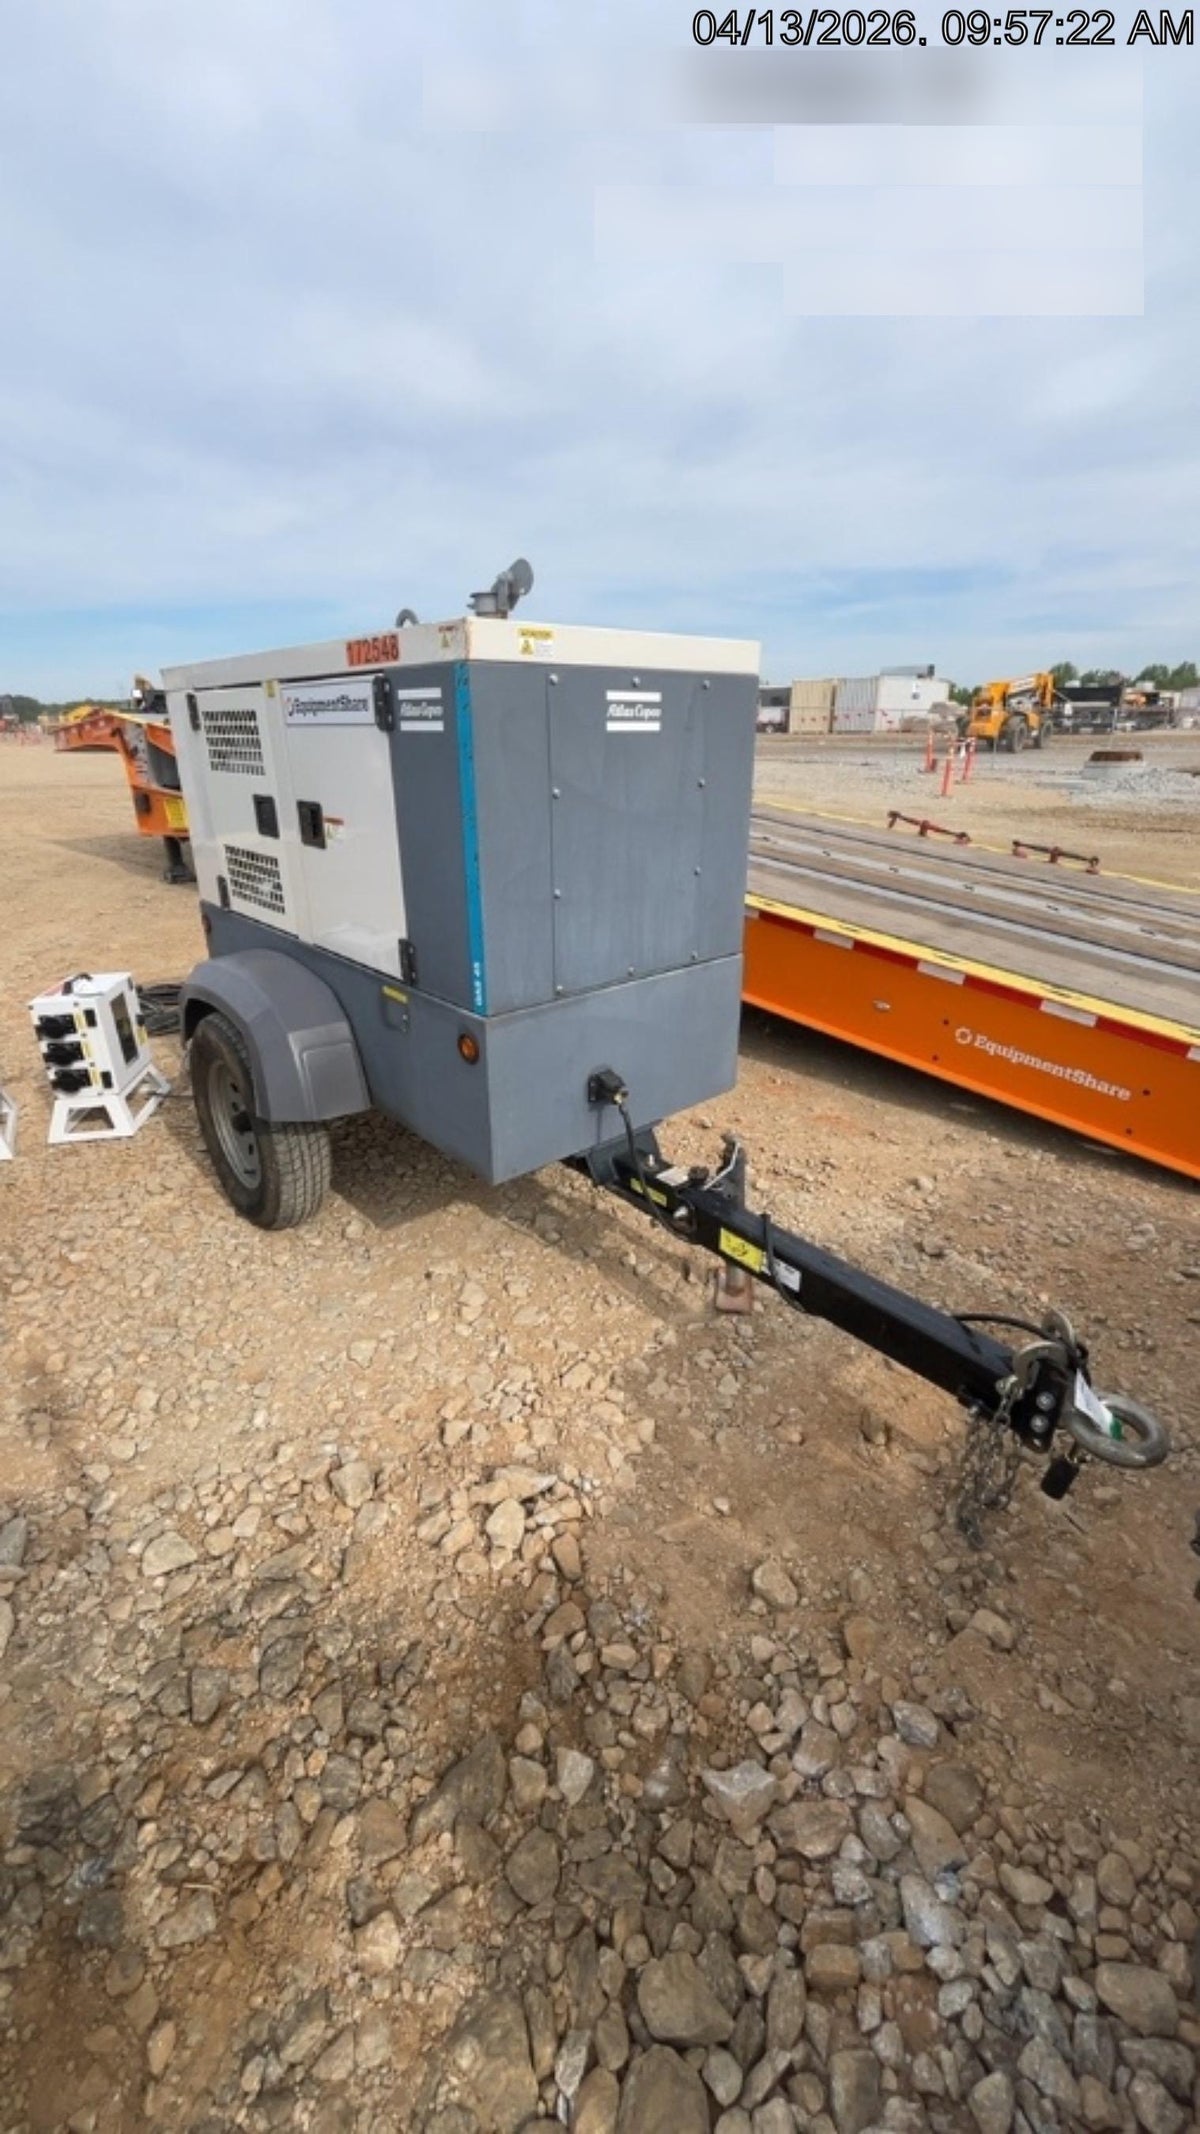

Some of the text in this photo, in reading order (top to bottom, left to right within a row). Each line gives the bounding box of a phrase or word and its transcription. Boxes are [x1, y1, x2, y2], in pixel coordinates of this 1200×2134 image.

[346, 634, 399, 666] 172548
[606, 703, 662, 721] Atlas Copco
[973, 1034, 1132, 1101] EquipmentShare
